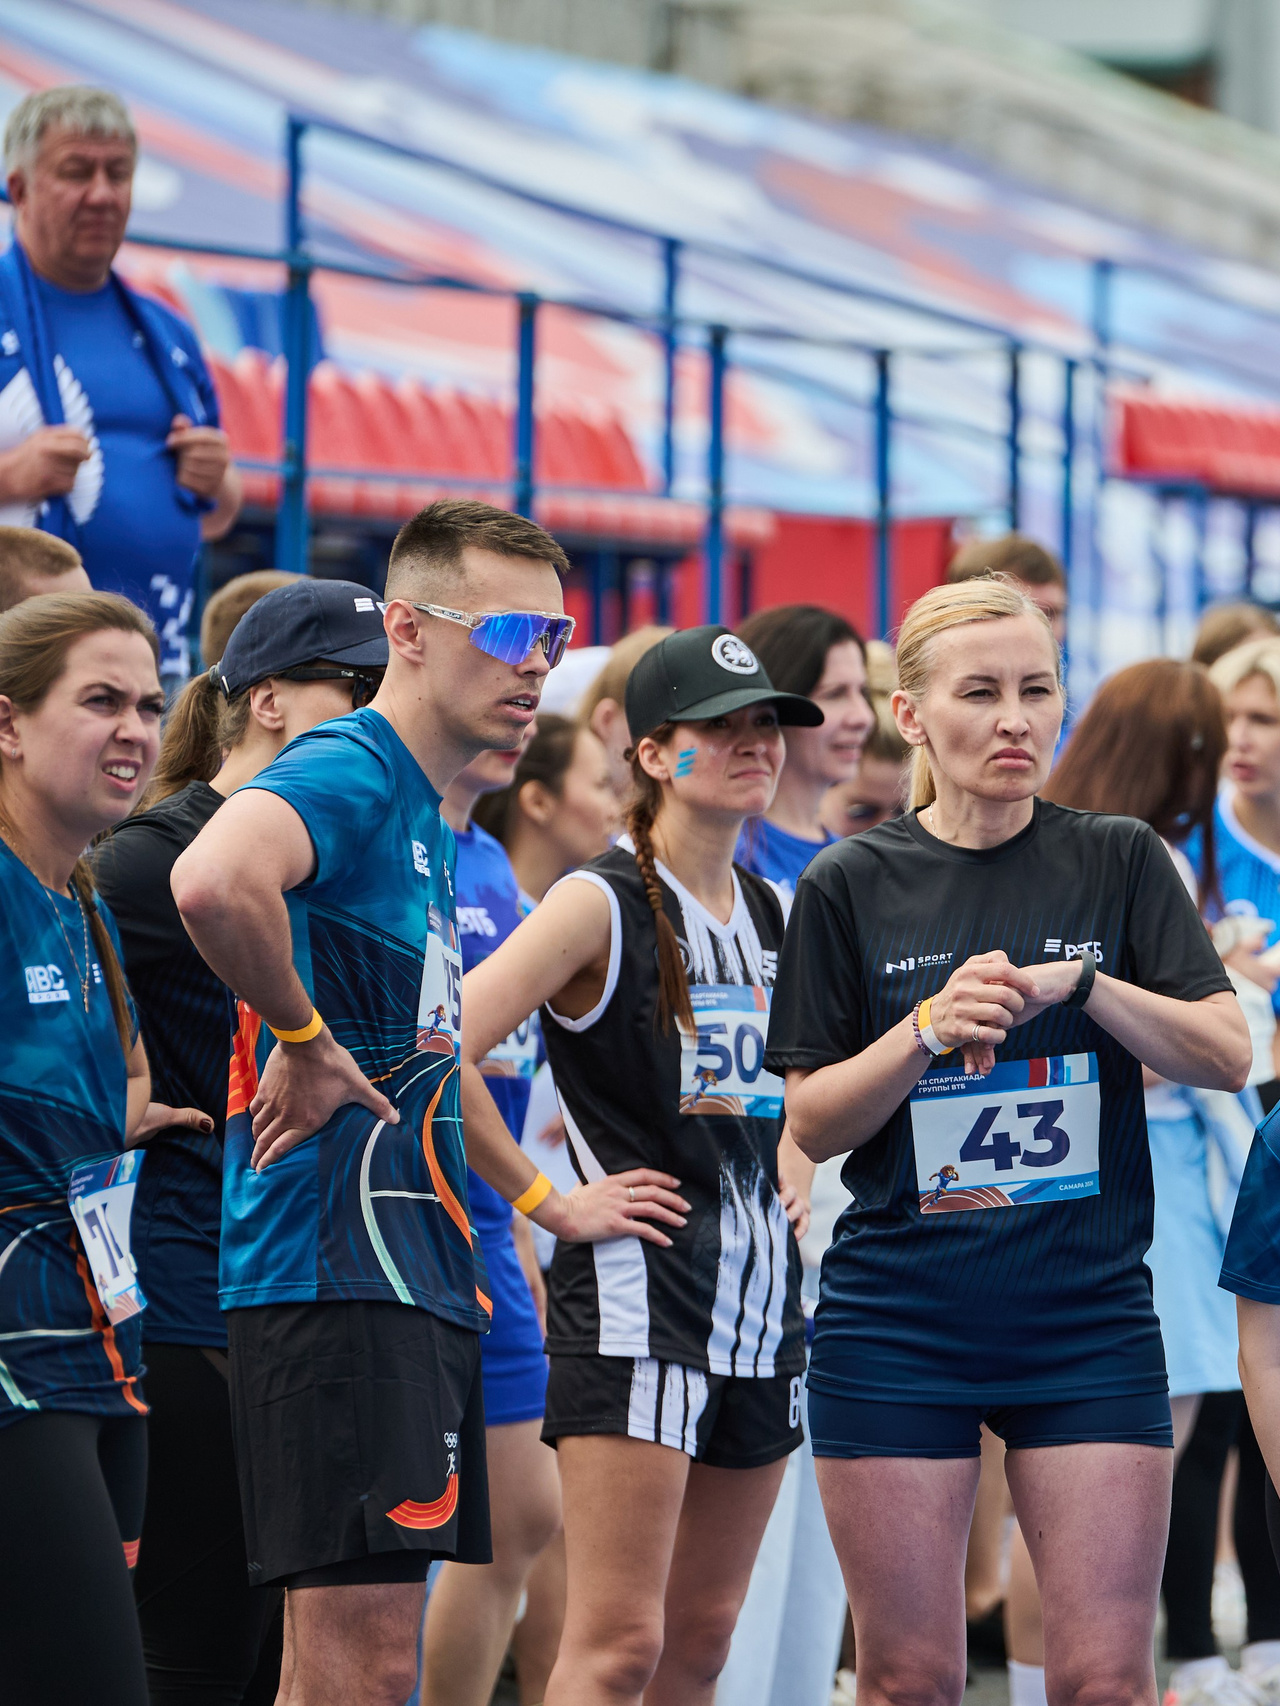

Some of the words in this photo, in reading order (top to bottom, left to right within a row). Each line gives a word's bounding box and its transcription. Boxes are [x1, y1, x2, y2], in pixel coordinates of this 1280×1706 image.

[917, 952, 953, 964] SPORT
[693, 1021, 765, 1083] 50
[928, 1074, 985, 1085] СПАРТАКИАДА
[918, 1085, 950, 1094] ГРУППЫ
[951, 1083, 966, 1091] ВТБ
[959, 1099, 1071, 1171] 43
[1058, 1182, 1085, 1191] САМАРА
